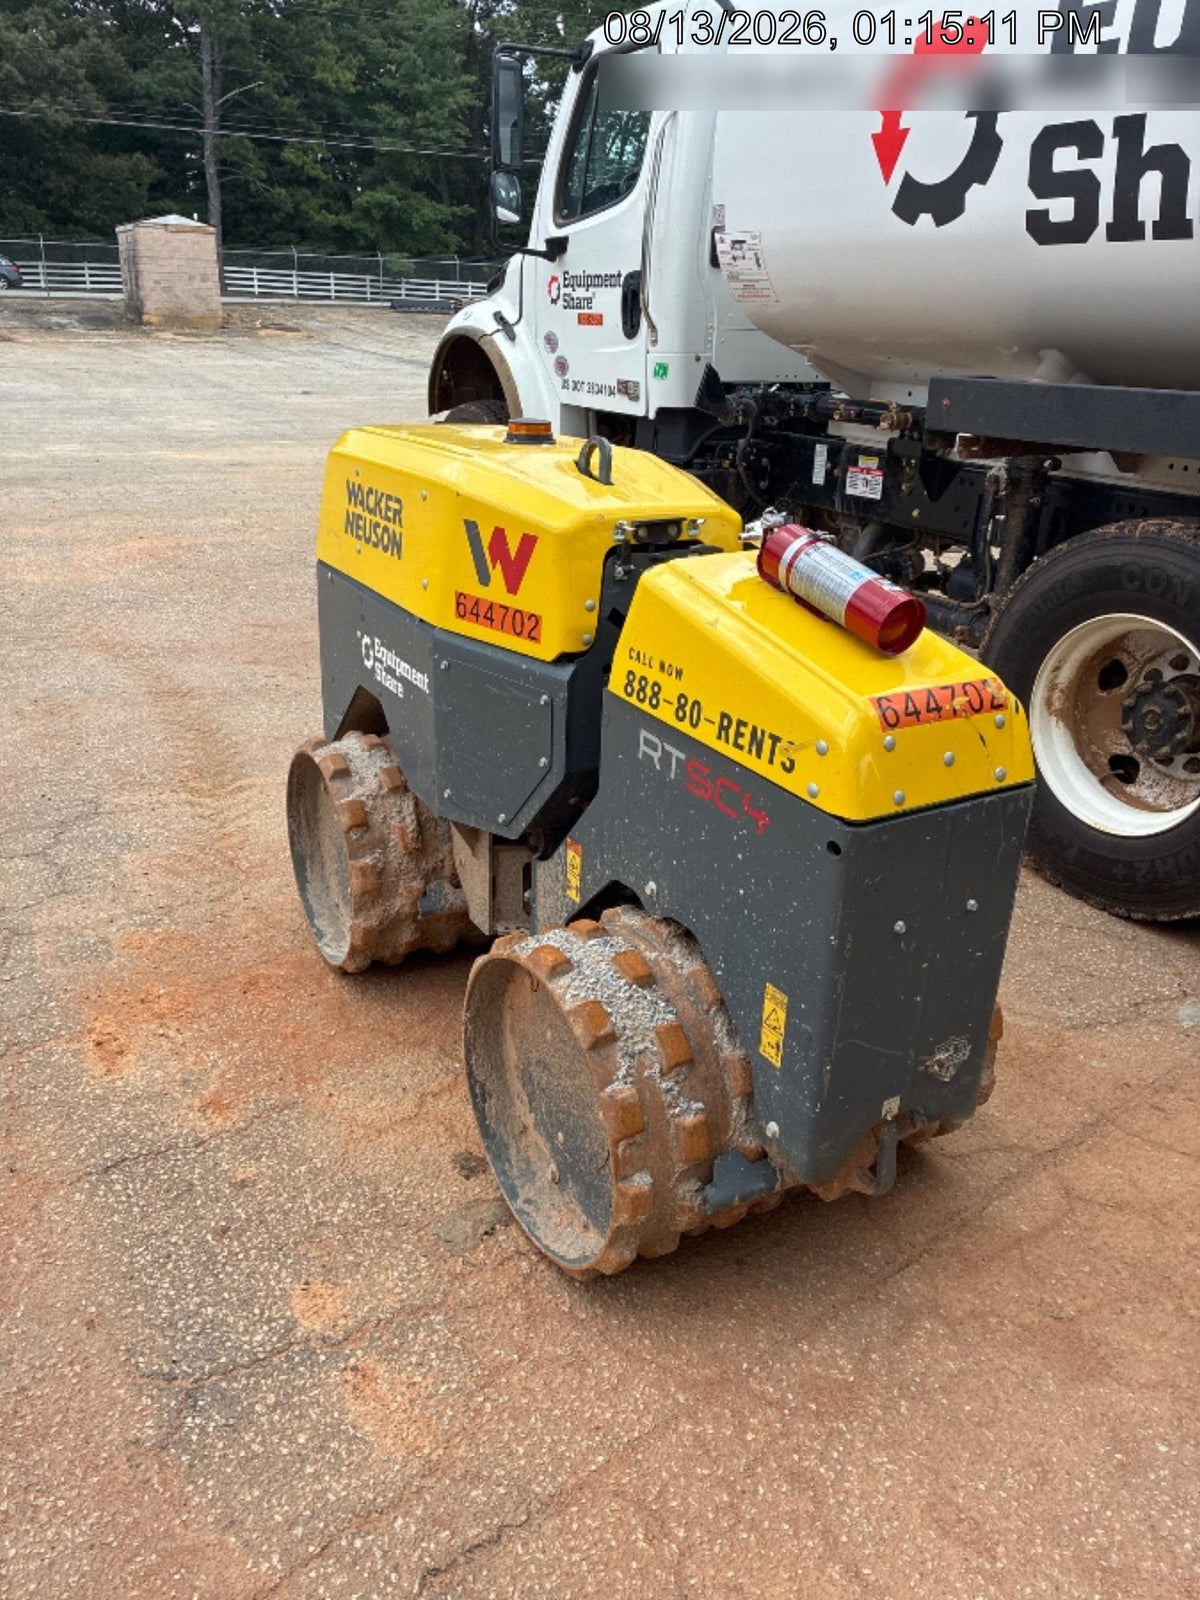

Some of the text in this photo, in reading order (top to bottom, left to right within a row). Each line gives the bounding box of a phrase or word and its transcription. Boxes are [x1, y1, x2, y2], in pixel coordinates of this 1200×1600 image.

[562, 270, 622, 292] Equipment
[562, 293, 593, 310] Share
[346, 479, 403, 527] WACKER
[344, 508, 403, 560] NEUSON
[455, 591, 540, 641] 644702
[373, 637, 430, 694] Equipment
[374, 662, 405, 698] Share
[628, 646, 684, 681] CALL NOW
